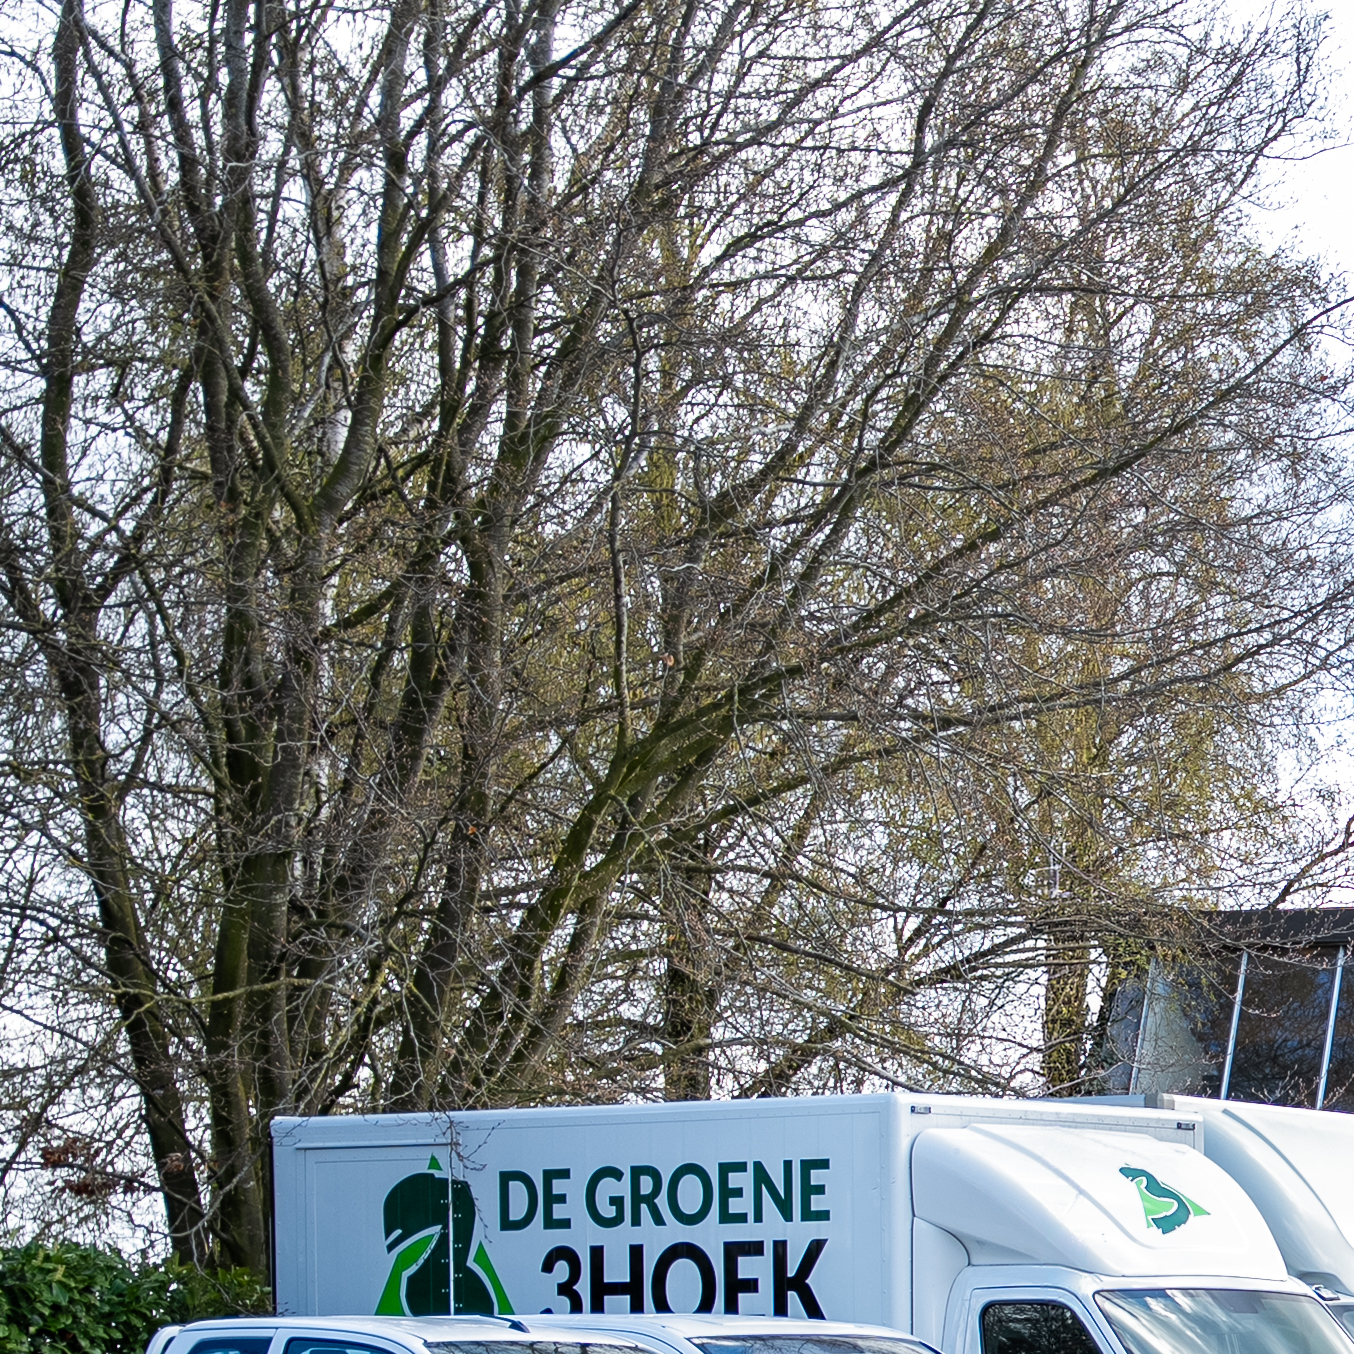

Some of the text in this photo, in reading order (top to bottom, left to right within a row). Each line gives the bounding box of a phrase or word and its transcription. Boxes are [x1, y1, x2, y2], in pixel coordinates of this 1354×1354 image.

[498, 1158, 831, 1232] DE GROENE
[540, 1238, 829, 1320] 3HOEK
